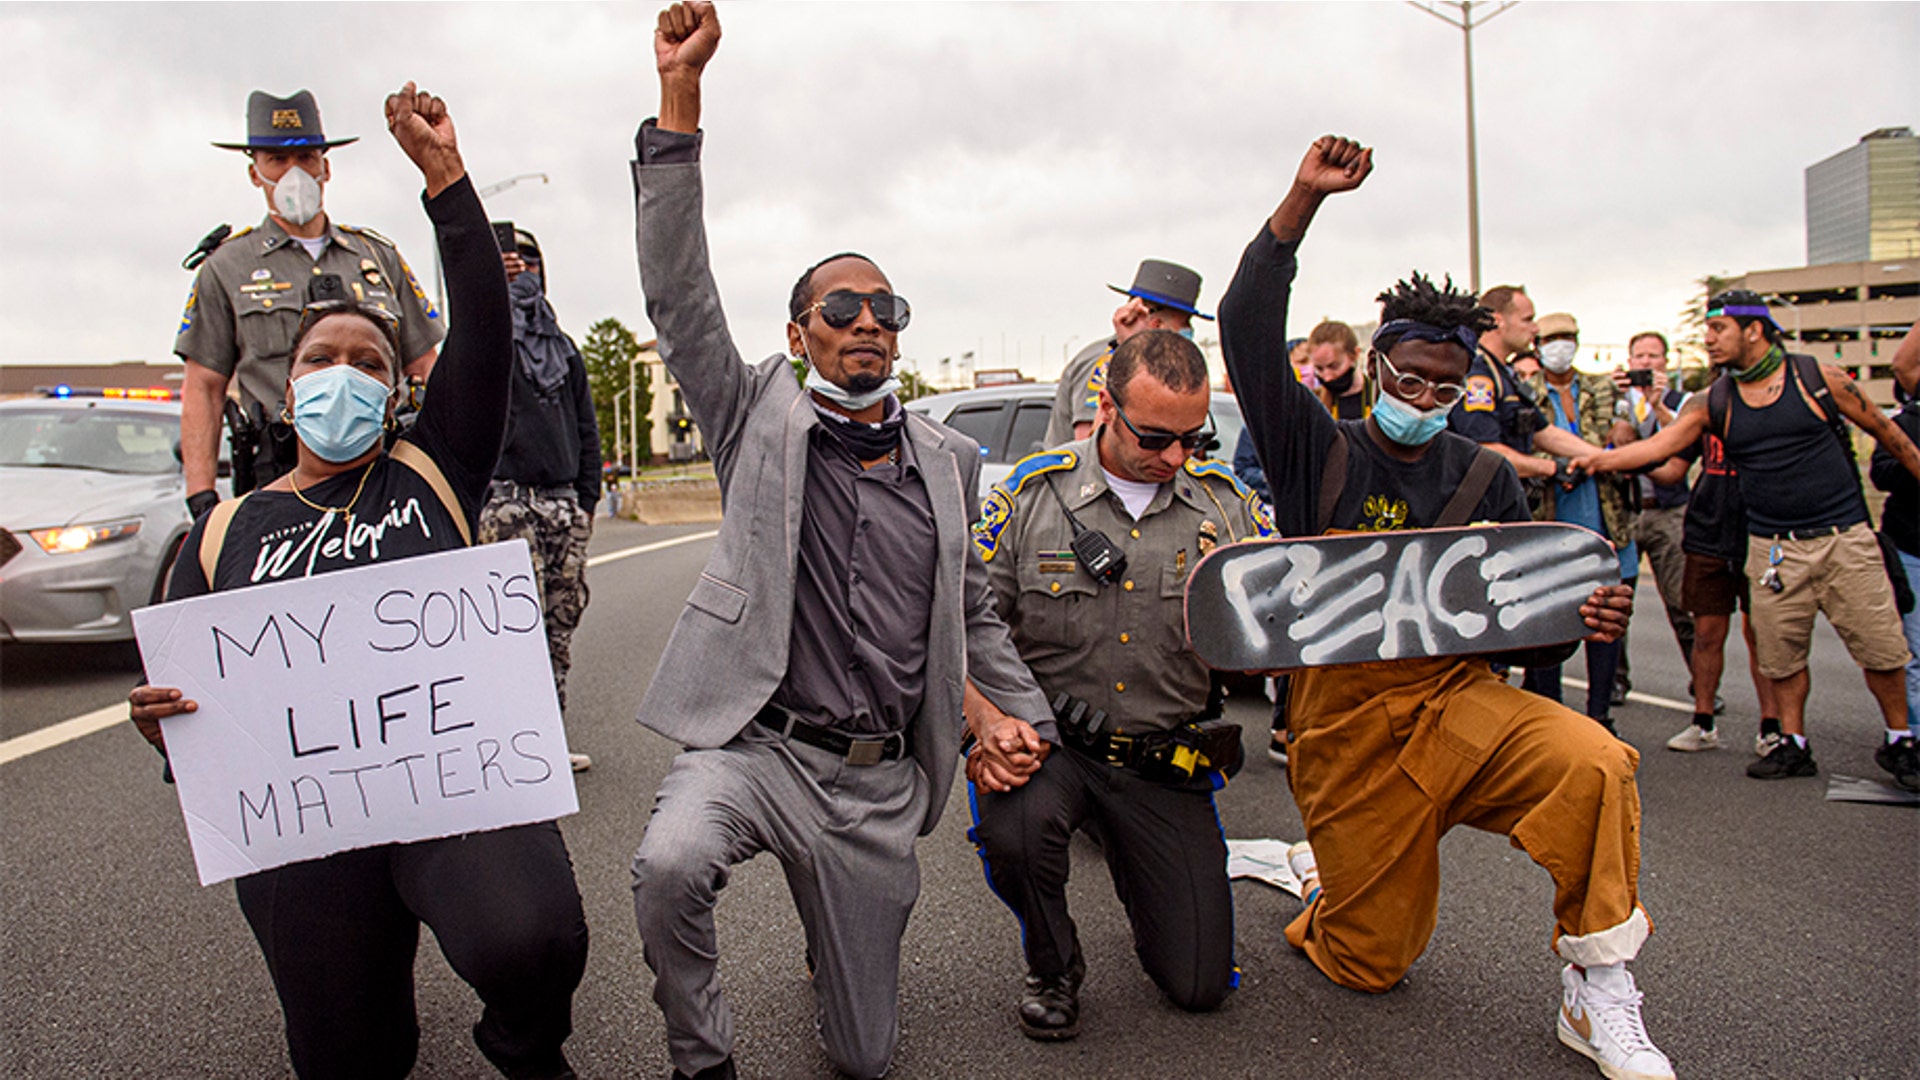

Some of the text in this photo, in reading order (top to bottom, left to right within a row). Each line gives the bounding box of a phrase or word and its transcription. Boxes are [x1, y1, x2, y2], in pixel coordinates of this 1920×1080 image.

[211, 571, 540, 678] MY SON'S
[1221, 531, 1617, 665] PEACE
[286, 676, 475, 759] LIFE
[238, 730, 552, 846] MATTERS
